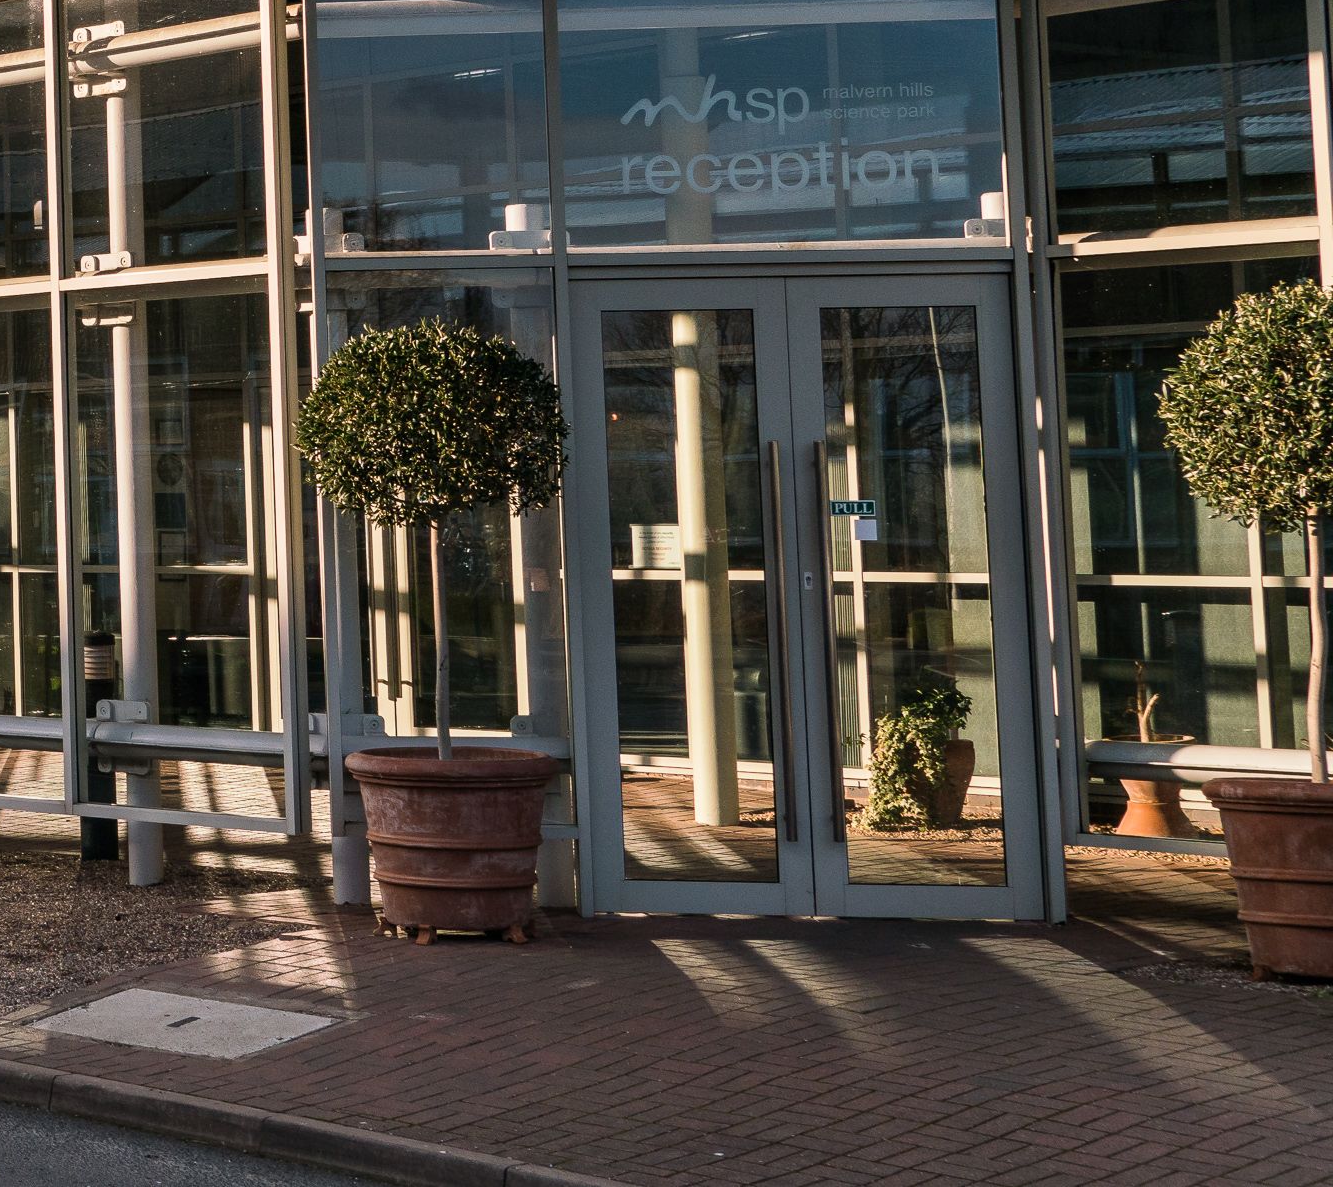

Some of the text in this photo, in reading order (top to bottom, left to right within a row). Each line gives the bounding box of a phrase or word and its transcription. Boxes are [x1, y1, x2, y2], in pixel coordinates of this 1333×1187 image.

[823, 82, 934, 99] malvern hills
[823, 103, 935, 120] science park
[620, 137, 940, 203] reception
[834, 502, 872, 514] PULL
